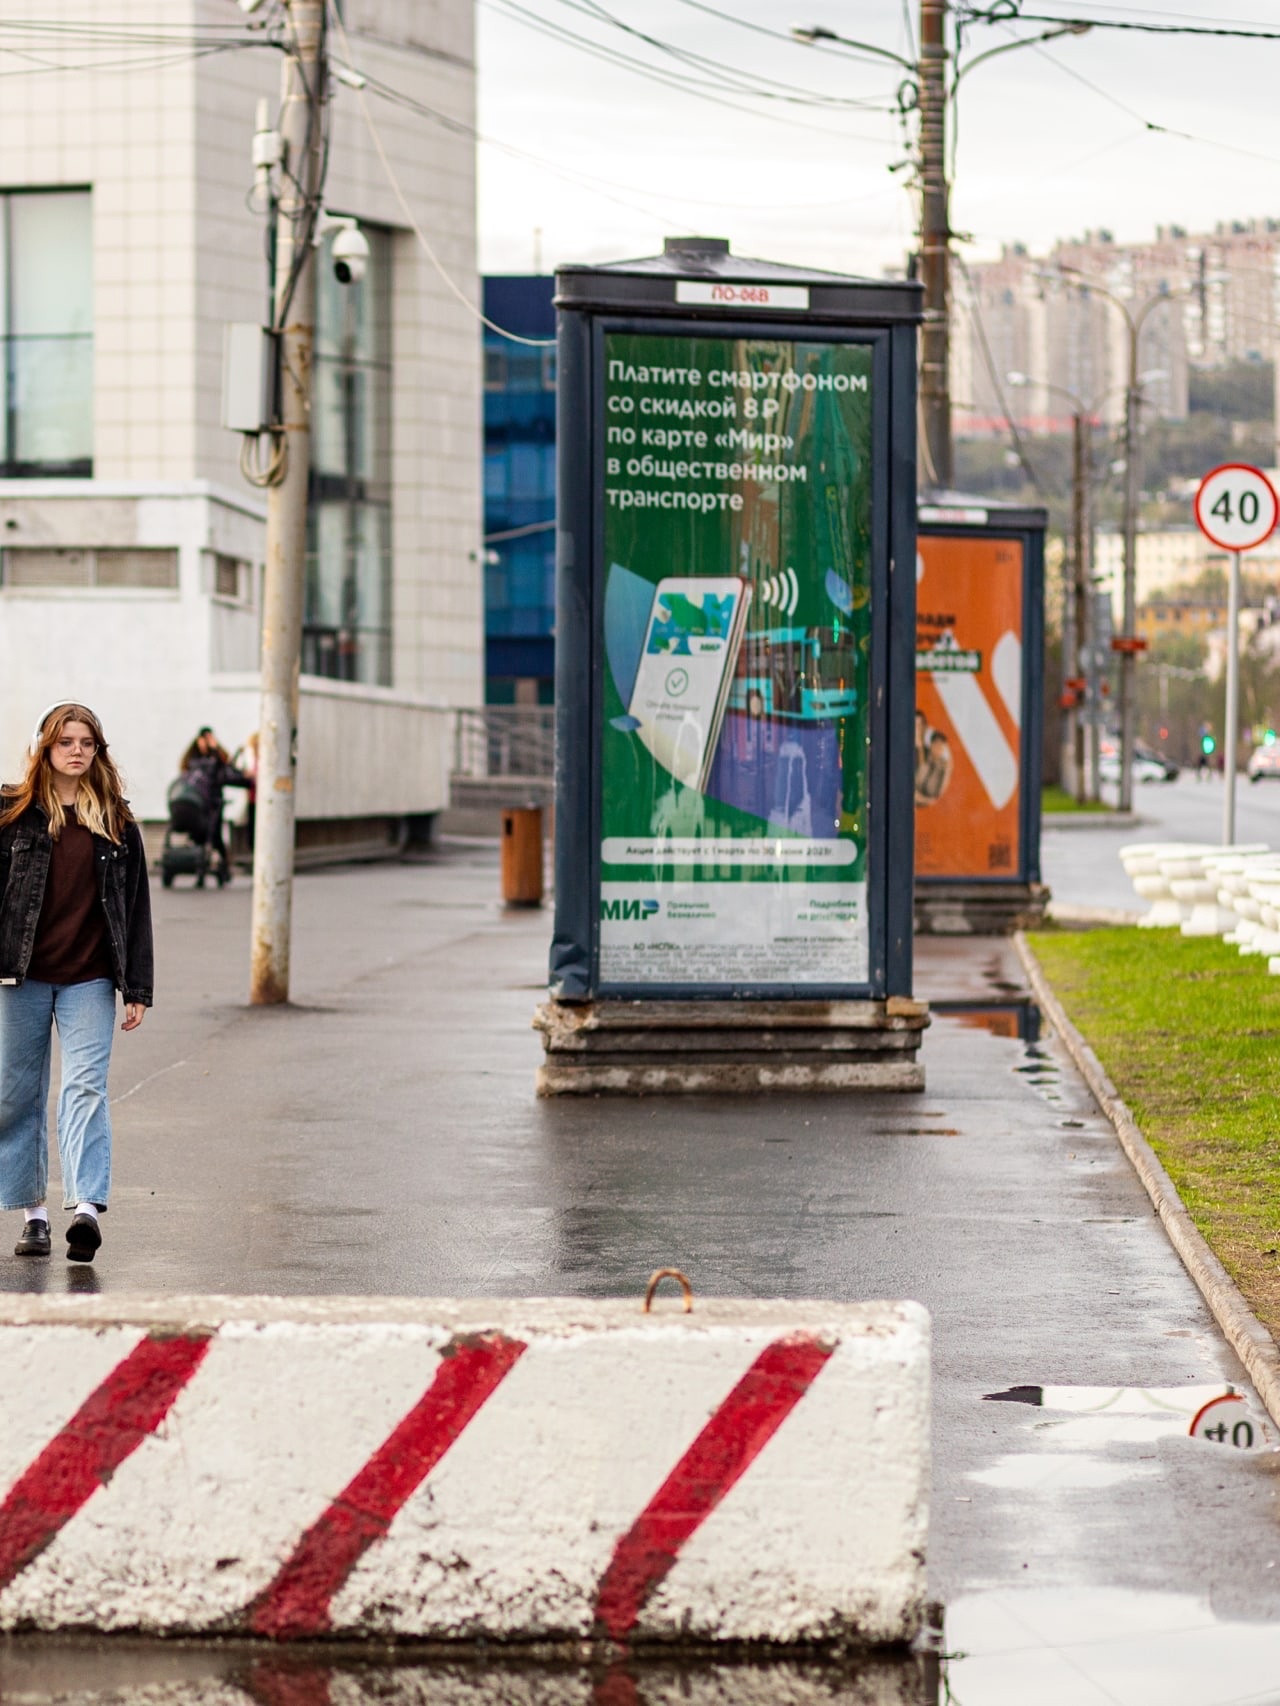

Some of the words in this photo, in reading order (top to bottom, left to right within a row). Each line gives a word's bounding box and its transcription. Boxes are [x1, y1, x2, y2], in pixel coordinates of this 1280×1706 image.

[608, 360, 701, 385] Платите
[708, 368, 867, 392] смартфоном
[608, 396, 634, 413] со
[640, 396, 737, 419] скидкой
[607, 428, 635, 445] по
[642, 430, 707, 450] карте
[715, 428, 794, 454] «Мир»
[607, 458, 620, 475] в
[627, 455, 807, 482] общественном
[606, 488, 744, 513] транспорте
[1210, 490, 1259, 524] 40
[600, 899, 660, 920] МИР
[809, 899, 857, 909] Подробнее
